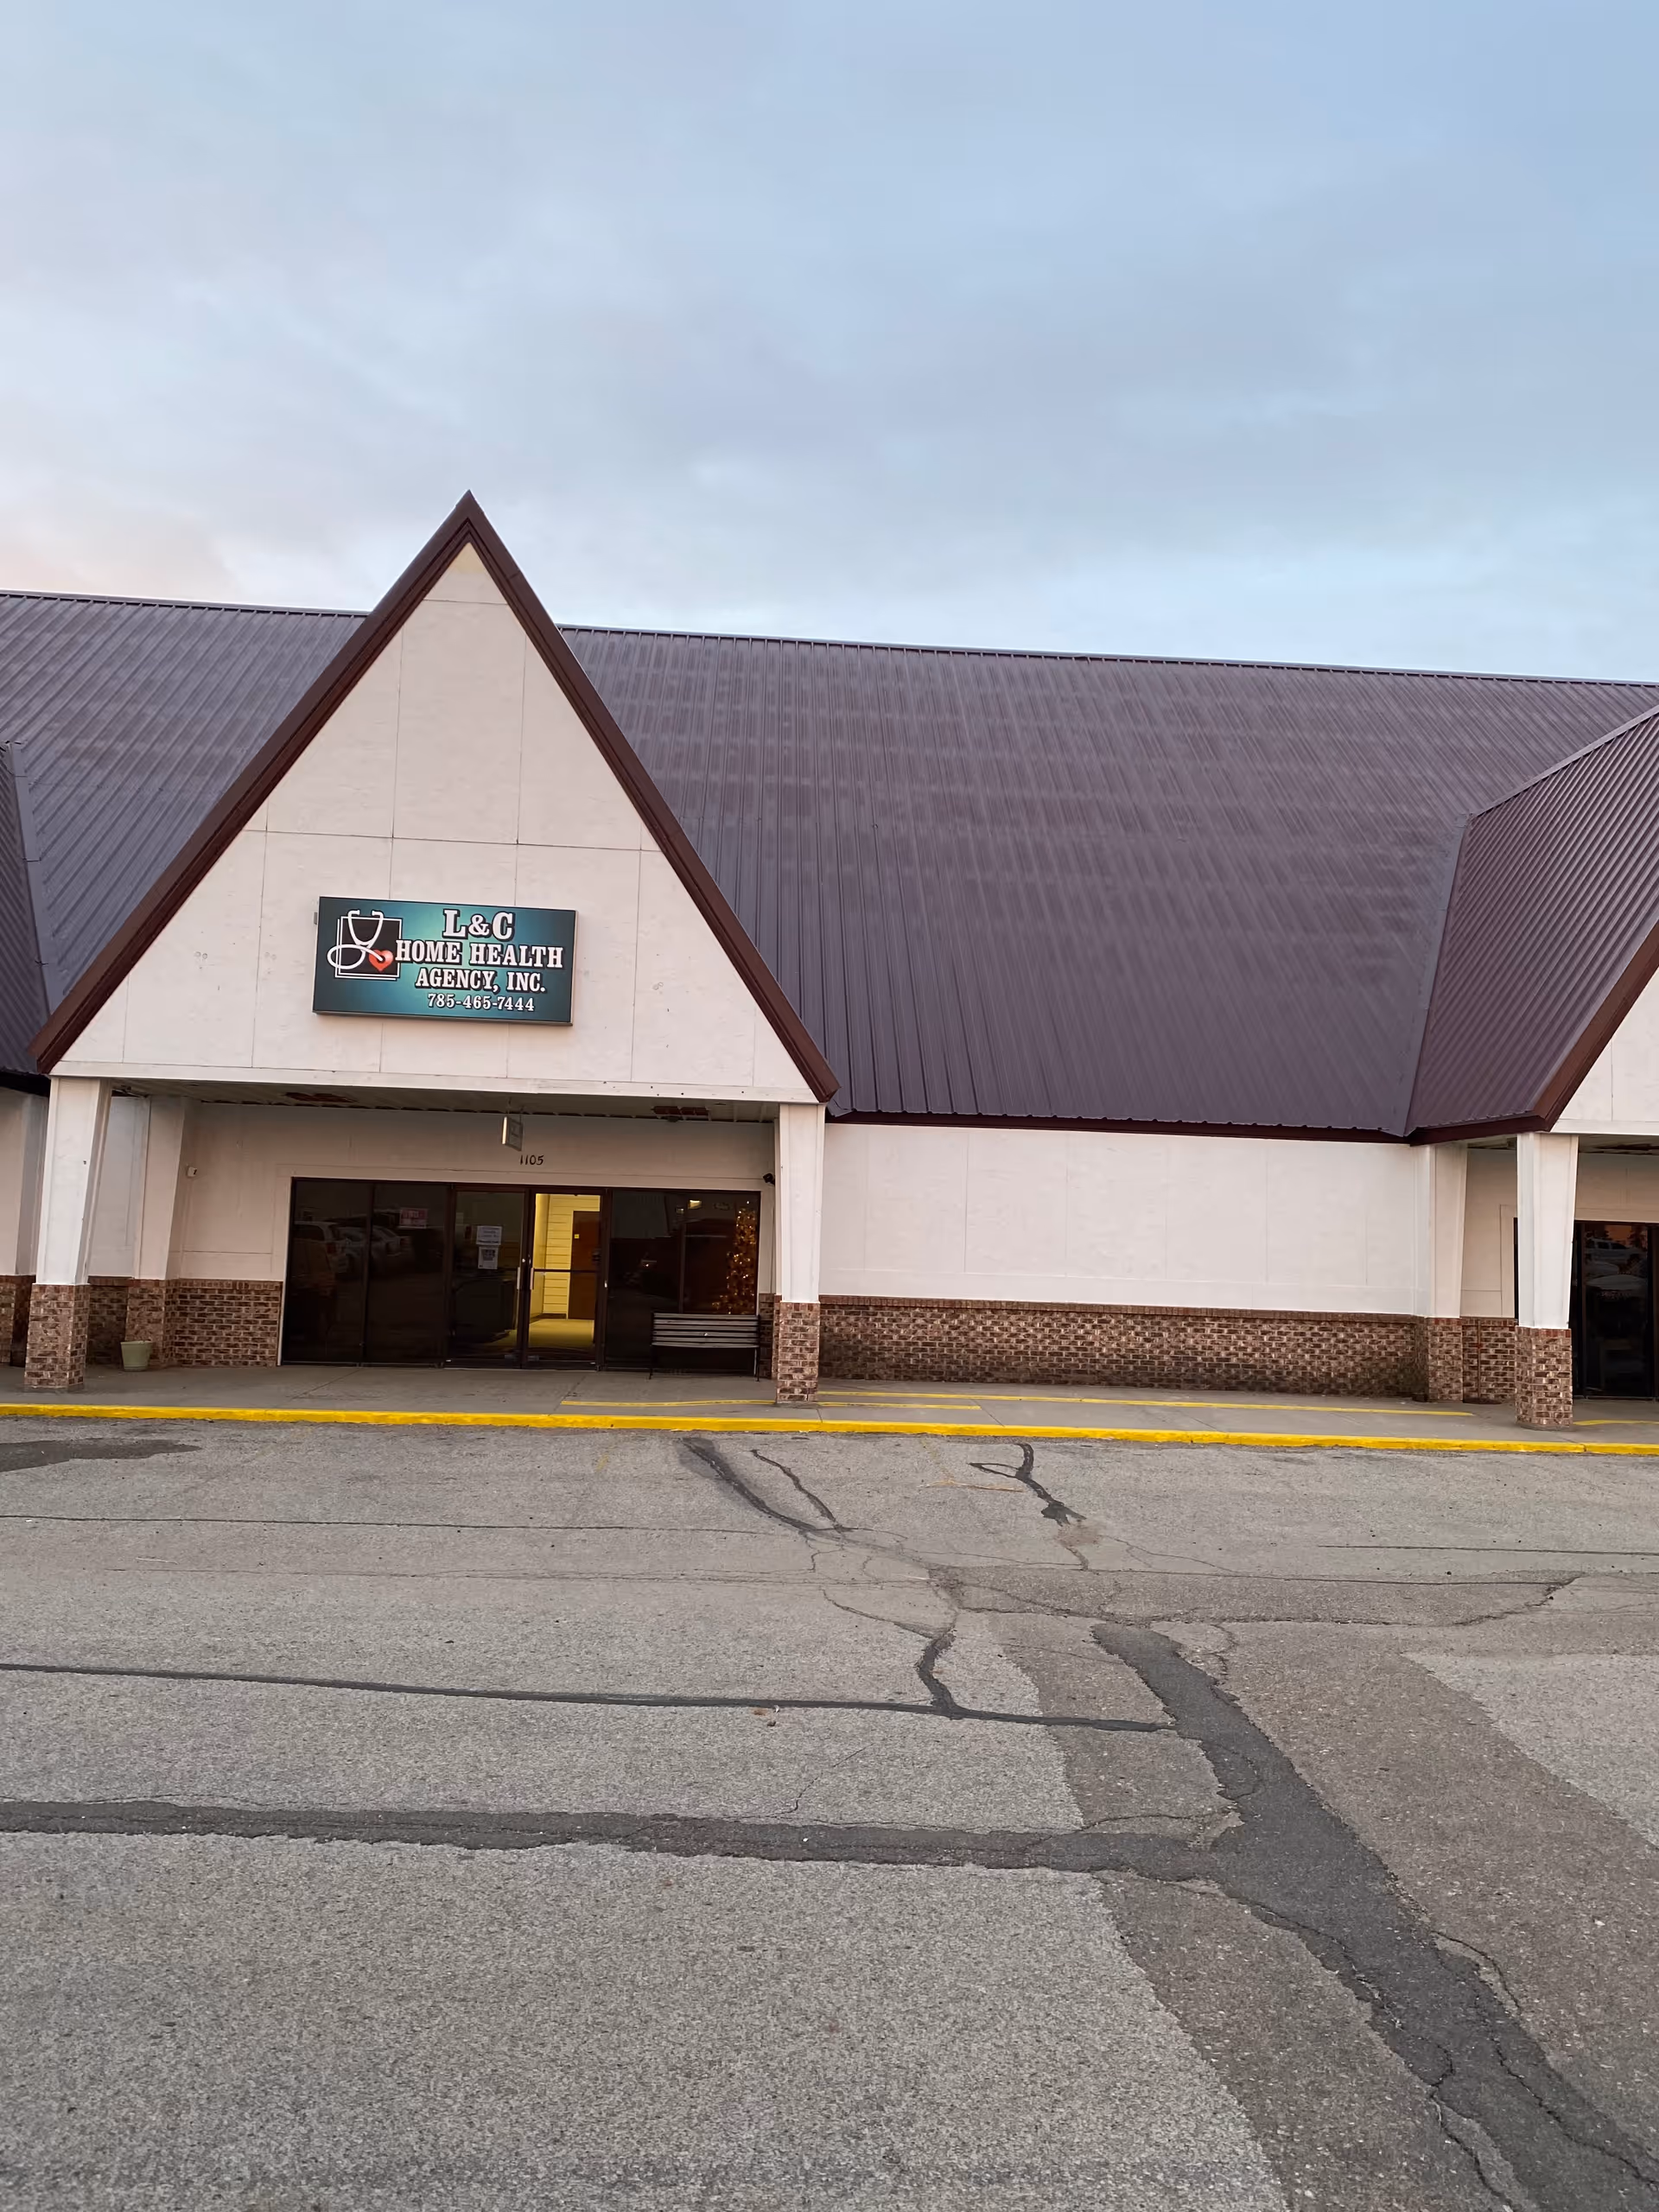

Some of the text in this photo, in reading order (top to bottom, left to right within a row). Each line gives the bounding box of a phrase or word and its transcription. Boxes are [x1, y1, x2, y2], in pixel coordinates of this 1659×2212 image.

[443, 909, 513, 939] L&C
[395, 939, 563, 968] HOME HEALTH
[416, 968, 545, 992] AGENCY, INC.
[428, 994, 534, 1011] 785-465-7444
[520, 1154, 543, 1165] 1105
